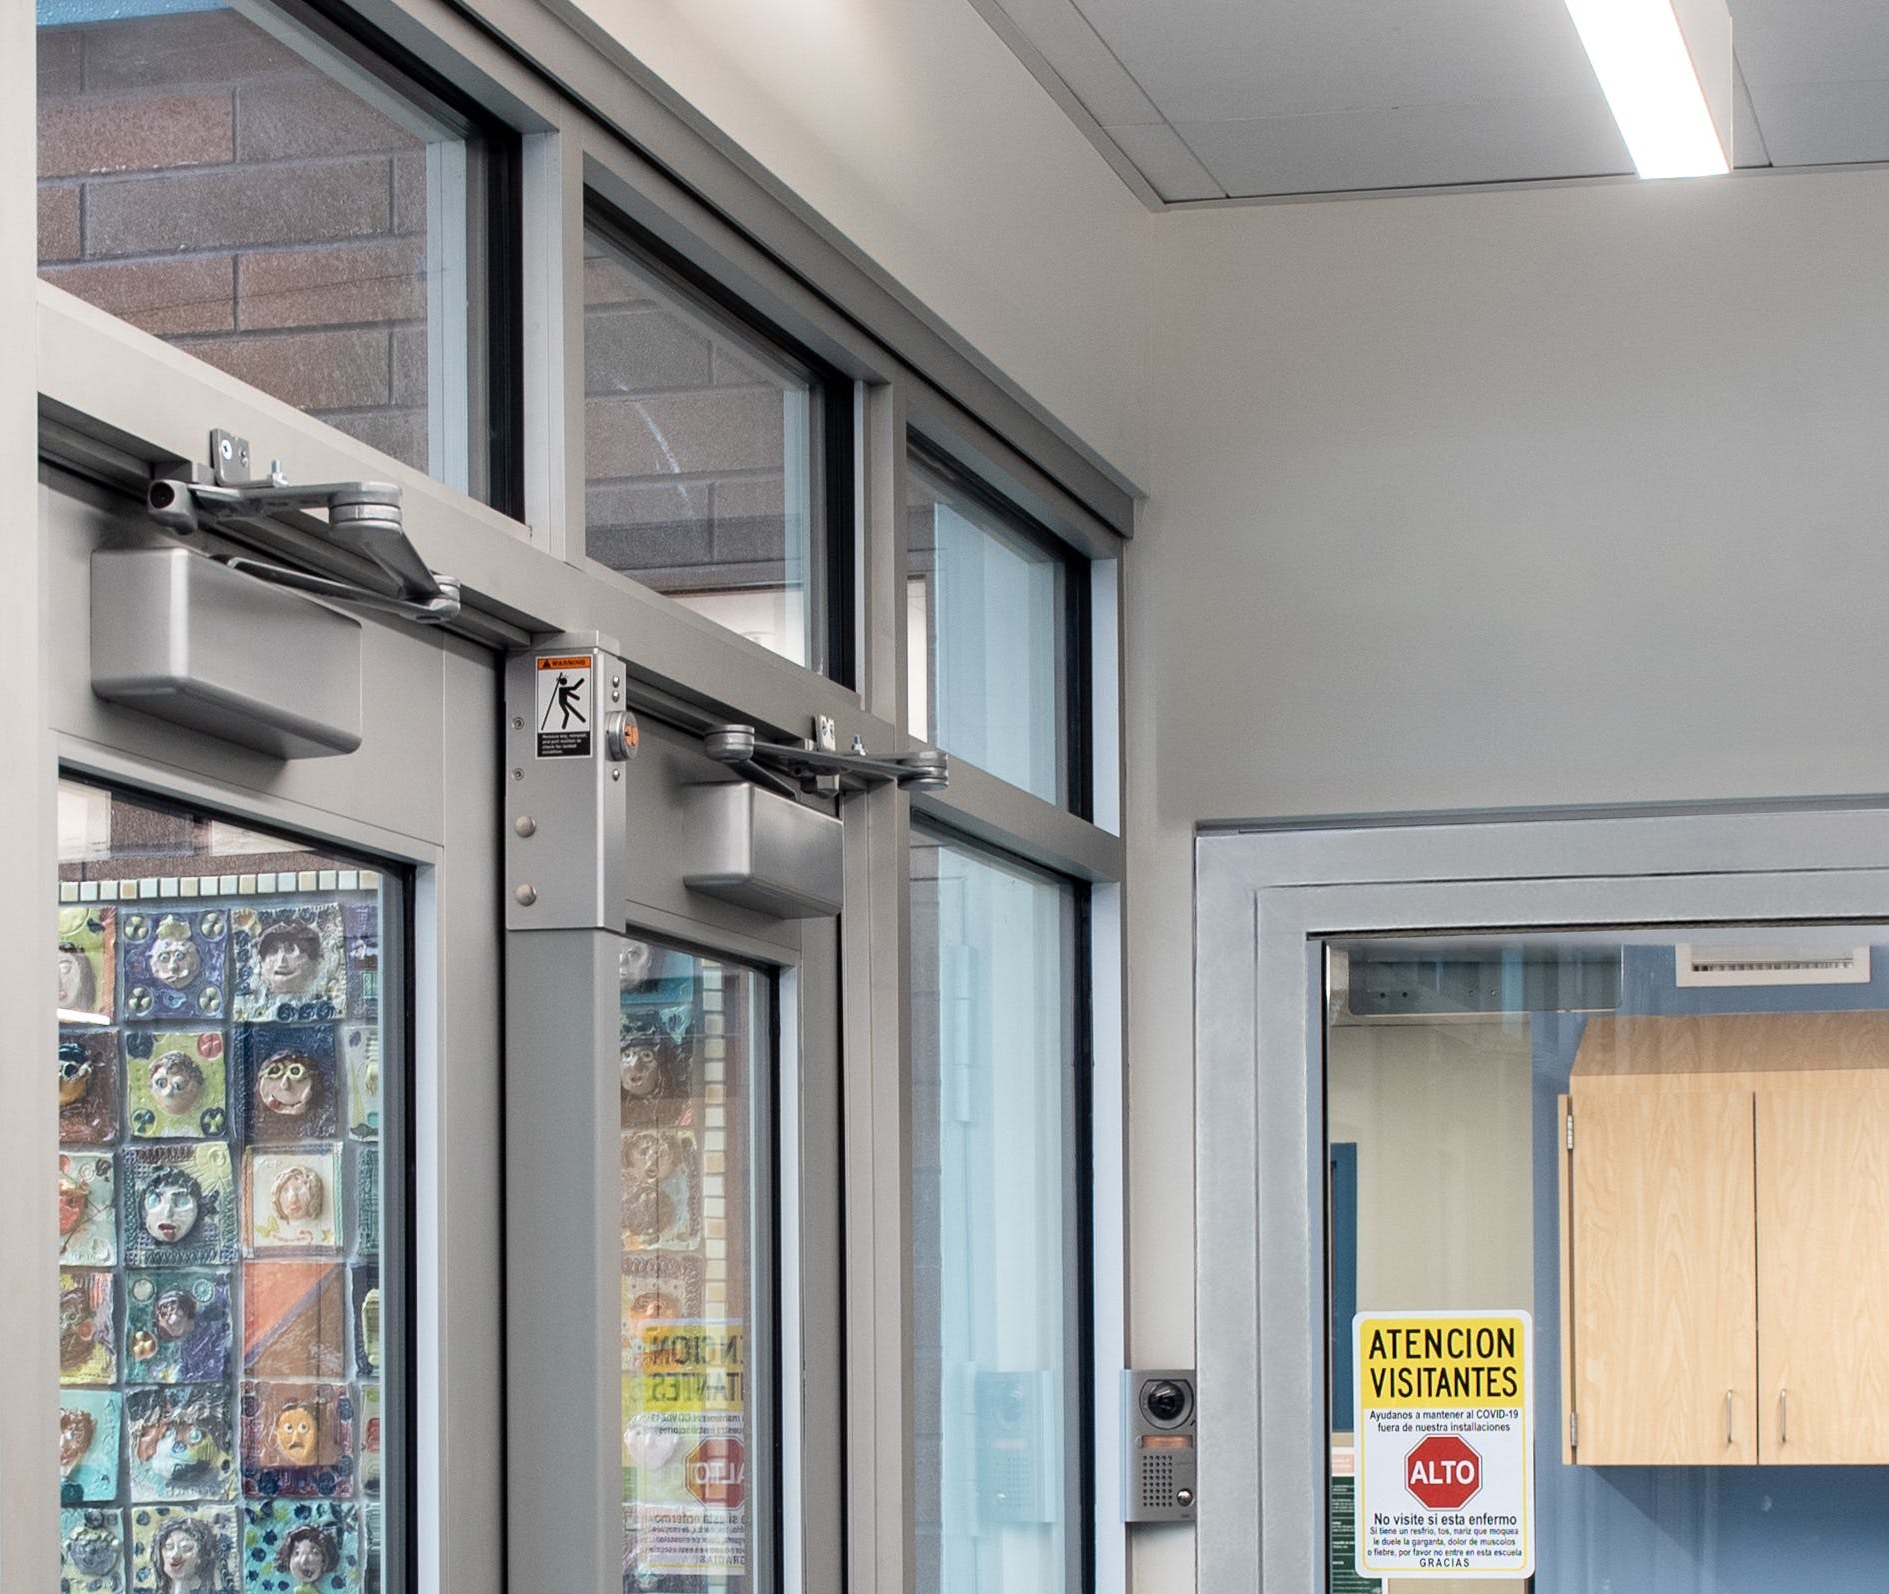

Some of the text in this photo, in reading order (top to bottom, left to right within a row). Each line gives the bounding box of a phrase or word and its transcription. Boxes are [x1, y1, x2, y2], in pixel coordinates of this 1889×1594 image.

[1369, 1328, 1515, 1359] ATENCION
[1370, 1367, 1518, 1398] VISITANTES
[1370, 1410, 1413, 1421] Ayudanos
[1423, 1411, 1463, 1419] mantener
[1466, 1410, 1473, 1419] al
[1476, 1410, 1519, 1419] COVID-19
[1378, 1423, 1399, 1432] fuera
[1402, 1423, 1412, 1431] de
[1451, 1422, 1510, 1431] installaciones
[1410, 1460, 1475, 1485] ALTO
[1374, 1513, 1517, 1525] No visite si esta enfermo
[1419, 1558, 1470, 1567] GRACIAS
